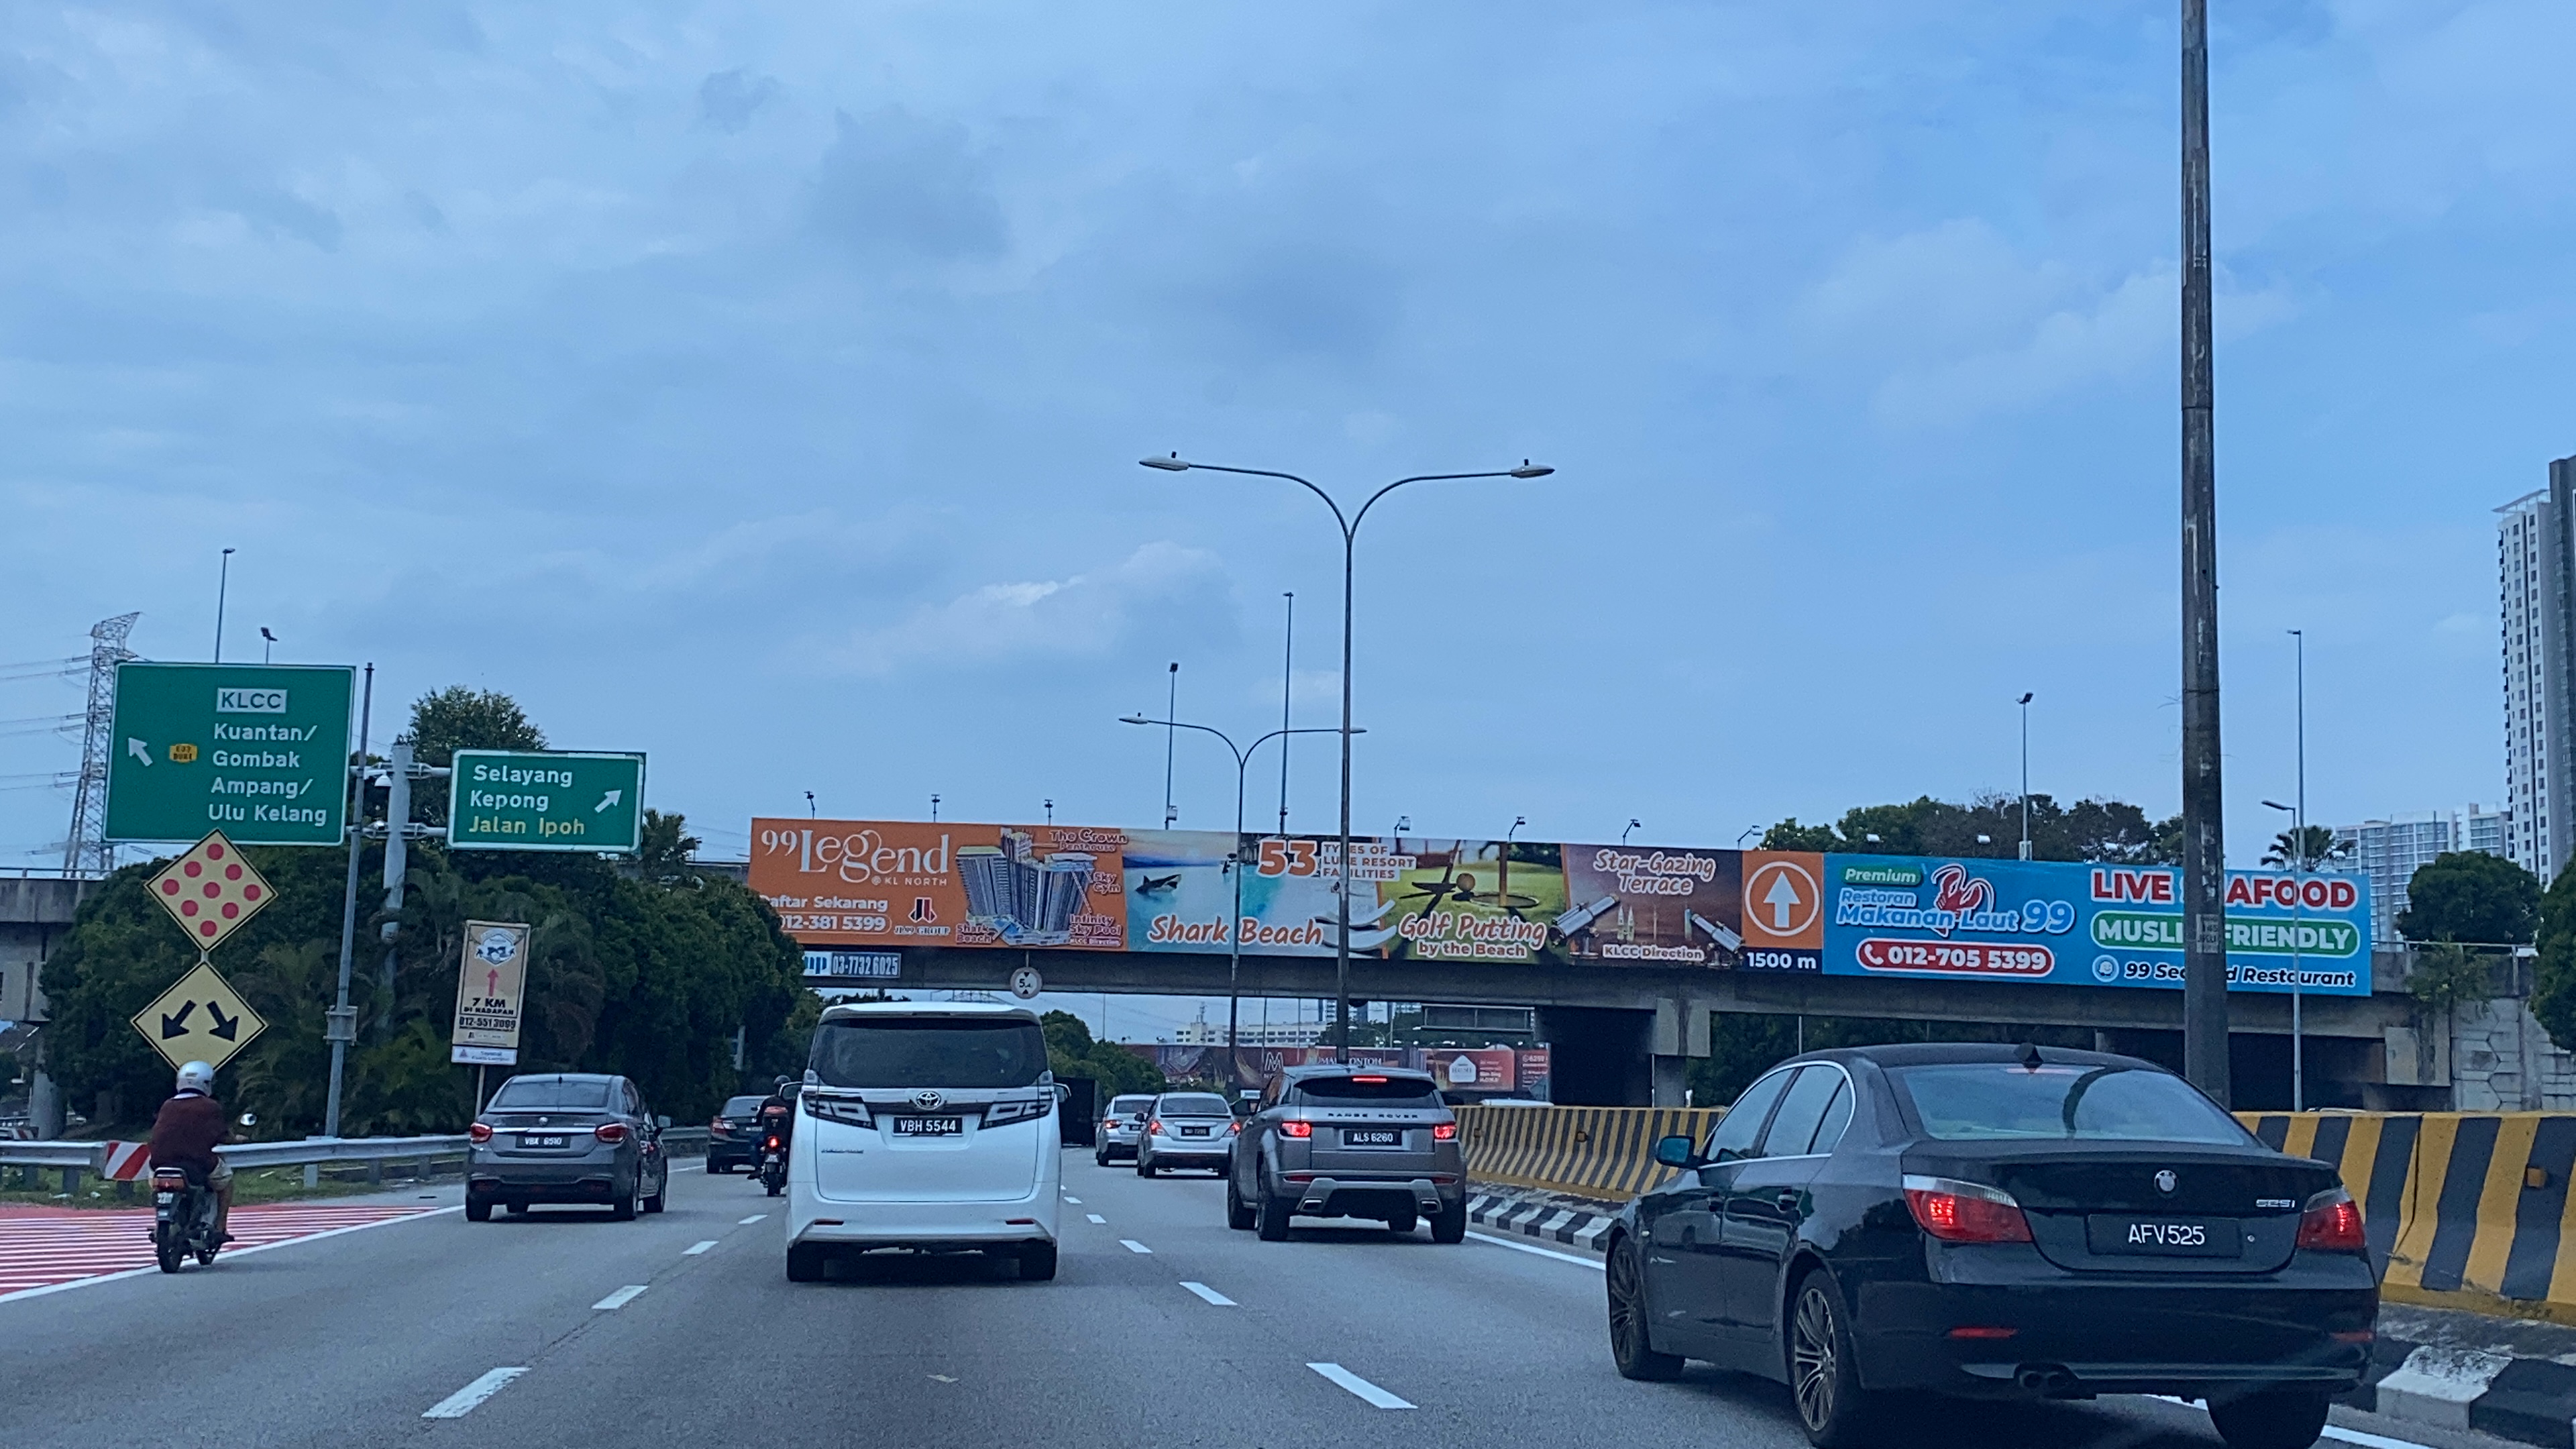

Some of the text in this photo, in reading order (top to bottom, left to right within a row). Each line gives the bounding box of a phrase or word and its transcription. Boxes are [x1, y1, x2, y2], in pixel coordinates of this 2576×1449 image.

[221, 691, 283, 709] KLCC
[214, 723, 318, 741] Kuantan/
[212, 751, 300, 768] Gombak
[473, 765, 572, 788] Selayang
[211, 777, 313, 799] Ampang/
[470, 790, 549, 812] Kepong
[208, 804, 327, 826] Ulu Kelang
[468, 816, 584, 838] Jalan Ipoh
[1050, 828, 1128, 843] The Crown
[1324, 844, 1388, 855] TYES OF
[1257, 841, 1316, 876] 53
[1324, 856, 1415, 868] LUE RESORT
[1595, 851, 1714, 879] Star-Gazing
[884, 875, 898, 885] KL
[904, 876, 948, 887] NORTH
[1093, 871, 1117, 884] Sky
[1323, 868, 1395, 879] FAILITIES
[1844, 867, 1917, 884] Premium
[1093, 881, 1121, 895] Gym
[1619, 873, 1693, 893] Terrace
[2094, 871, 2356, 908] LIVE AFOOD
[813, 896, 888, 912] Sekarang
[1841, 890, 1915, 905] Restoran
[842, 916, 887, 931] 5399
[1069, 914, 1115, 926] Infinity
[1838, 901, 2074, 932] Makanan Laut 99
[916, 926, 951, 936] GROUP
[956, 924, 989, 934] Shark
[1069, 924, 1122, 936] Sky Pool
[1150, 914, 1323, 945] Shark Beach
[1400, 910, 1547, 951] Golf Putting
[2098, 919, 2184, 943] MUSLI
[956, 934, 992, 944] Beach
[1417, 941, 1525, 958] by the Beach
[1604, 946, 1703, 959] KLCC Direction
[832, 955, 871, 975] 03-7732
[872, 956, 898, 975] 6025
[1748, 951, 1817, 970] 1500 m
[1888, 947, 2046, 970] 012-705 5399
[2125, 963, 2356, 986] 99 Sed Restaurant
[472, 997, 506, 1008] 7 KM
[900, 1119, 957, 1132] VBH 5544
[1352, 1132, 1370, 1142] ALS
[2127, 1223, 2206, 1246] AFV525
